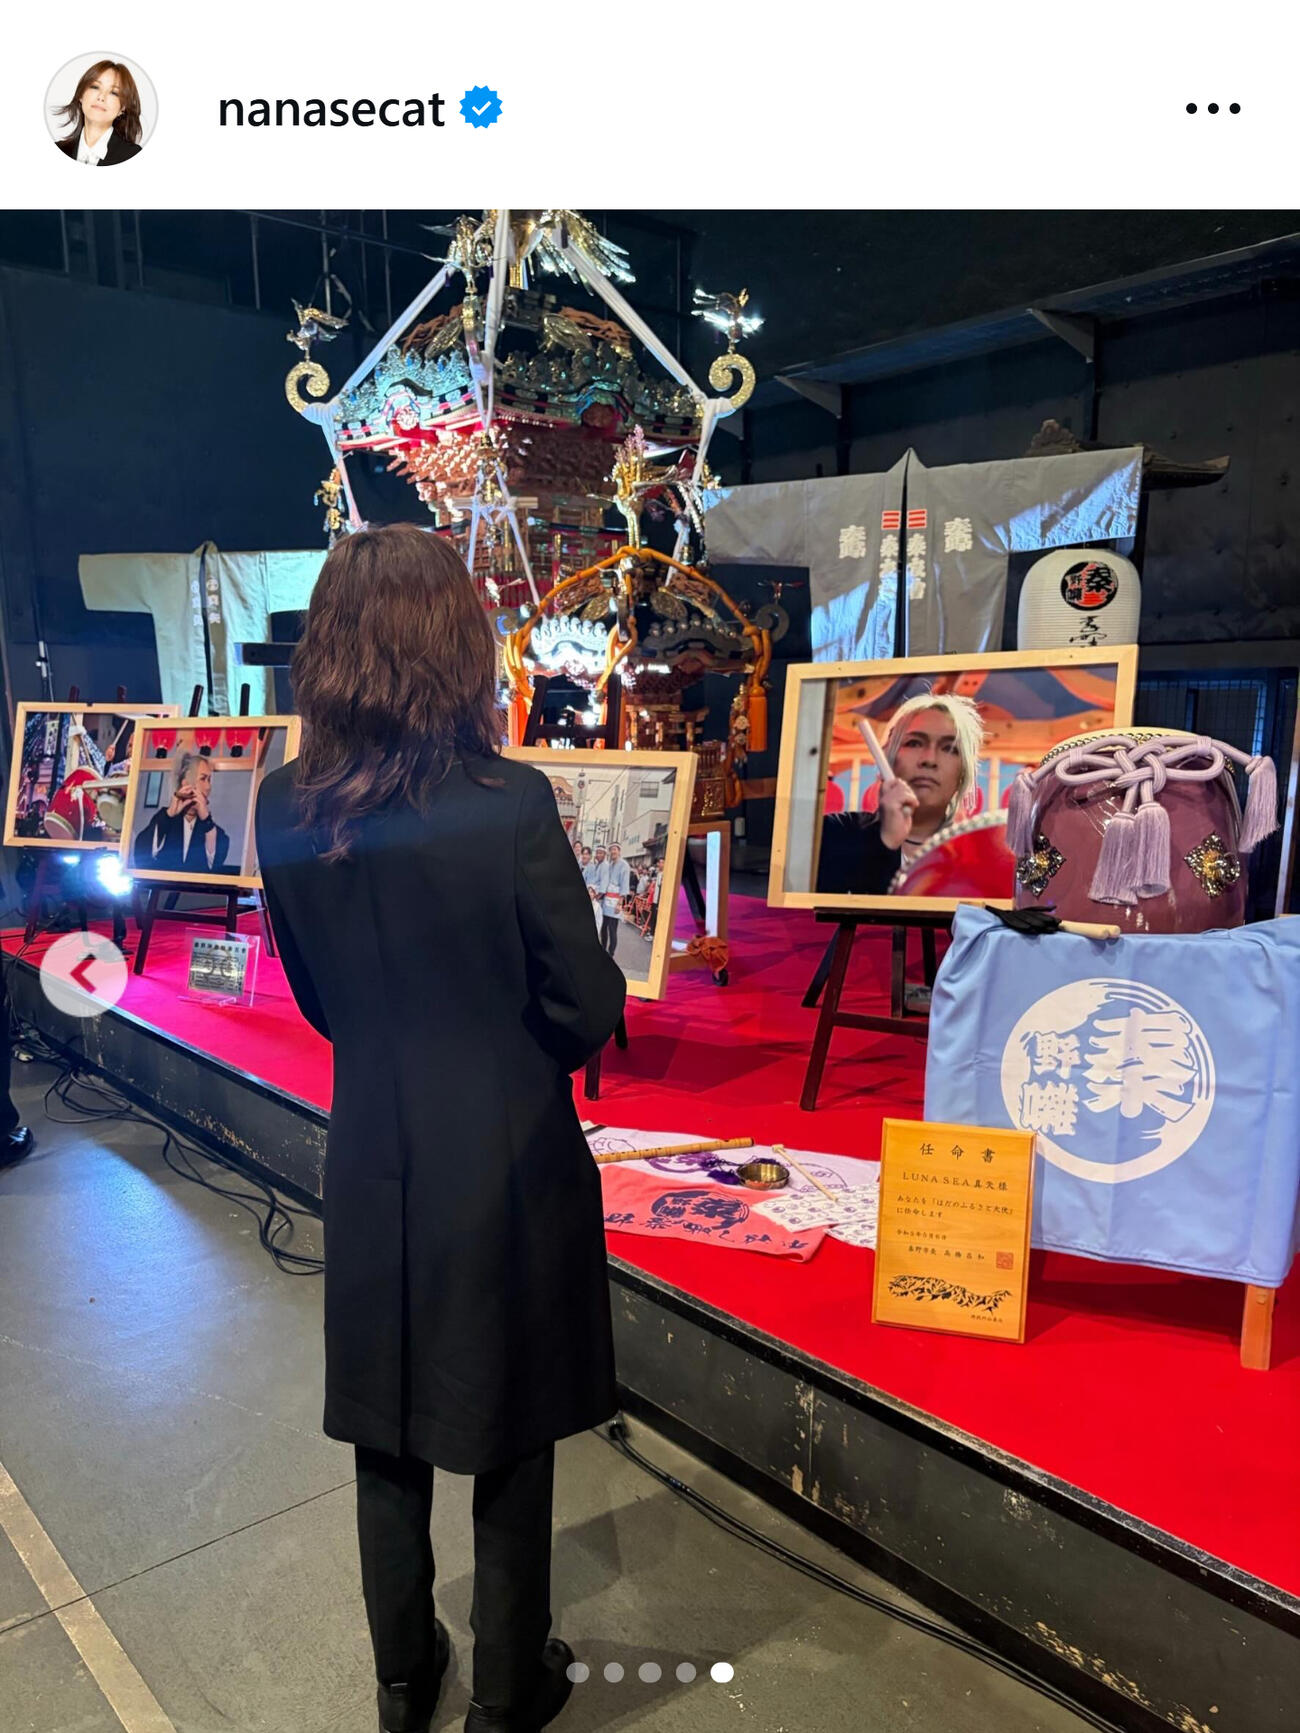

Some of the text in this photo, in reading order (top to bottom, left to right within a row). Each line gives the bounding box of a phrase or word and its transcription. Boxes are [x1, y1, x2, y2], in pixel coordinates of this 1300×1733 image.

[920, 1142, 995, 1164] 任命書
[903, 1171, 938, 1184] LUNA
